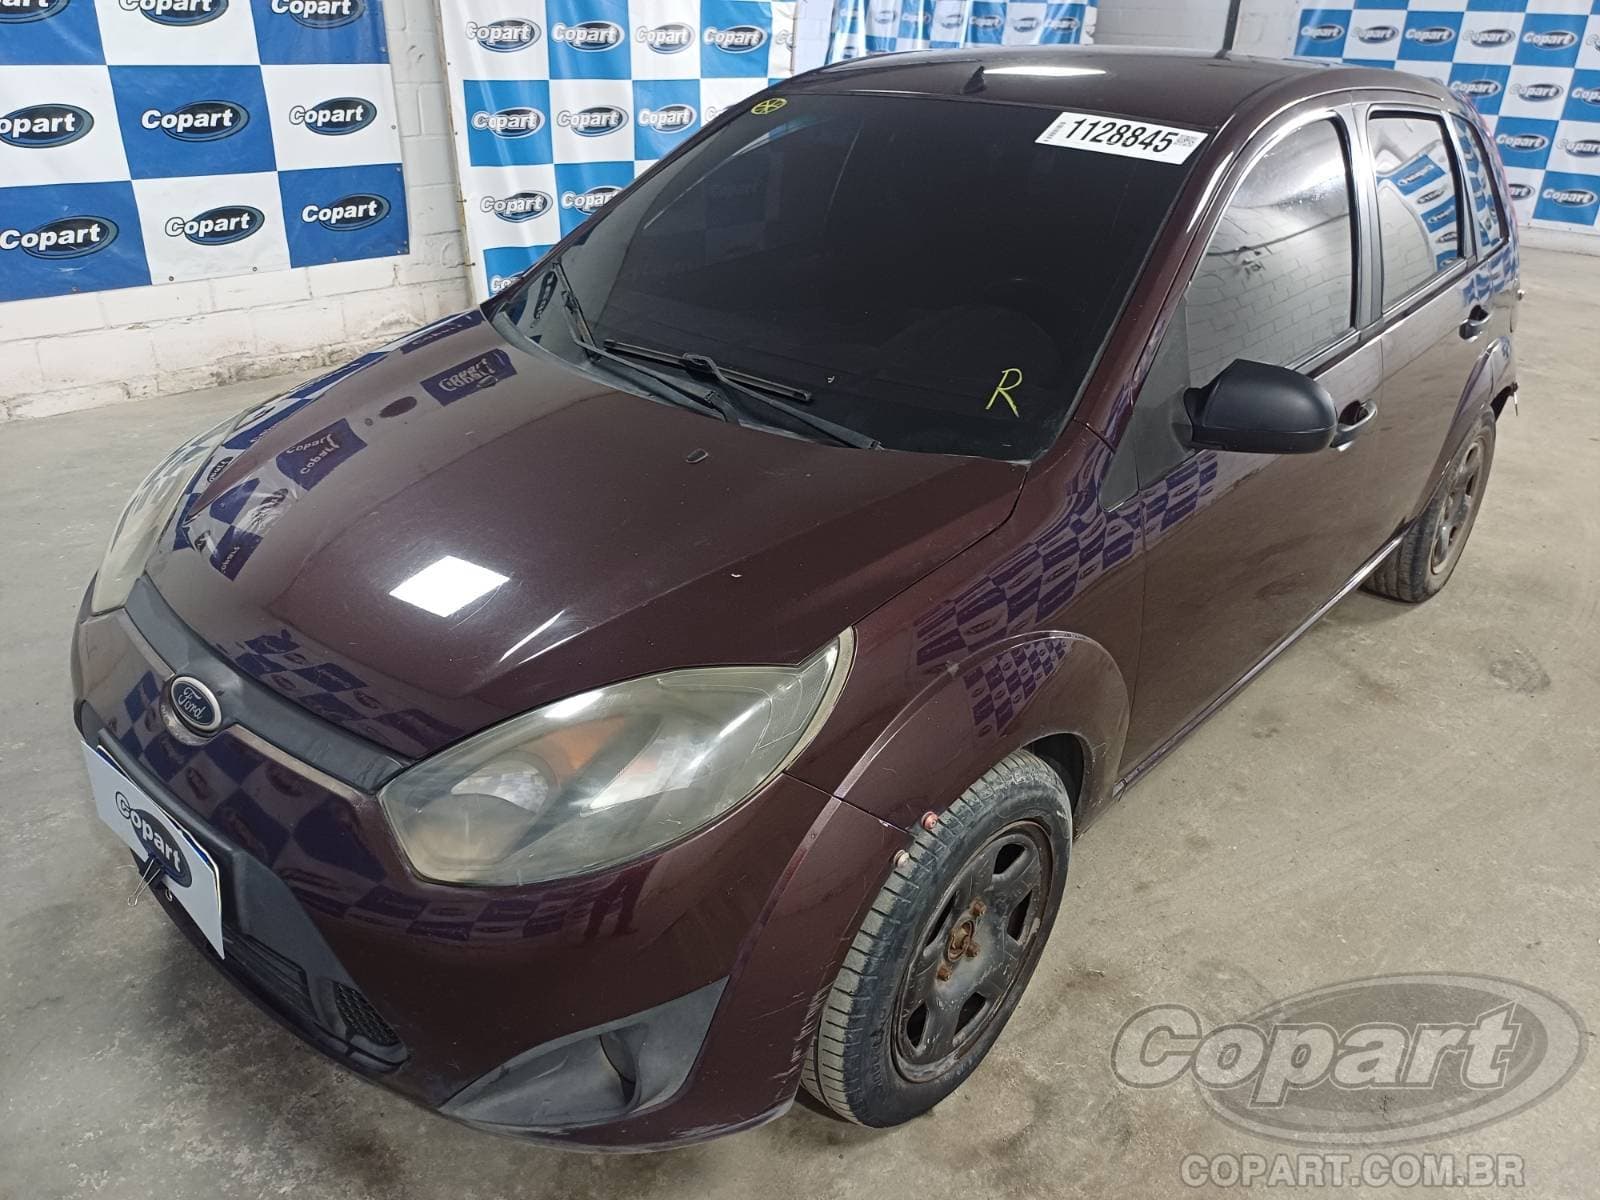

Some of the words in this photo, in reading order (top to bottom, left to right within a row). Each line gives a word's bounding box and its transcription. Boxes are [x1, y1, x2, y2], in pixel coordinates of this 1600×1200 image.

[466, 21, 531, 45] Copart
[553, 22, 619, 46] Copart
[635, 26, 688, 46] Copart
[704, 26, 762, 47] Copart
[1405, 28, 1450, 42] Copart
[1463, 29, 1509, 43] Copart
[1523, 32, 1572, 45] Copart
[1450, 81, 1496, 95] Copart
[1510, 82, 1558, 98] Copart
[142, 110, 233, 132] Copart
[288, 105, 364, 127] Copart
[471, 111, 537, 133] Copart
[557, 110, 618, 130] Copart
[638, 108, 690, 129] Copart
[1066, 118, 1179, 152] 1128845
[1496, 133, 1542, 147] Copart
[480, 195, 543, 215] Copart
[1543, 189, 1590, 203] Copart
[302, 200, 378, 224] Copart
[0, 223, 101, 251] Copart
[165, 216, 251, 238] Copart
[985, 368, 1022, 418] R
[178, 686, 207, 721] Ford
[116, 791, 181, 873] Copart
